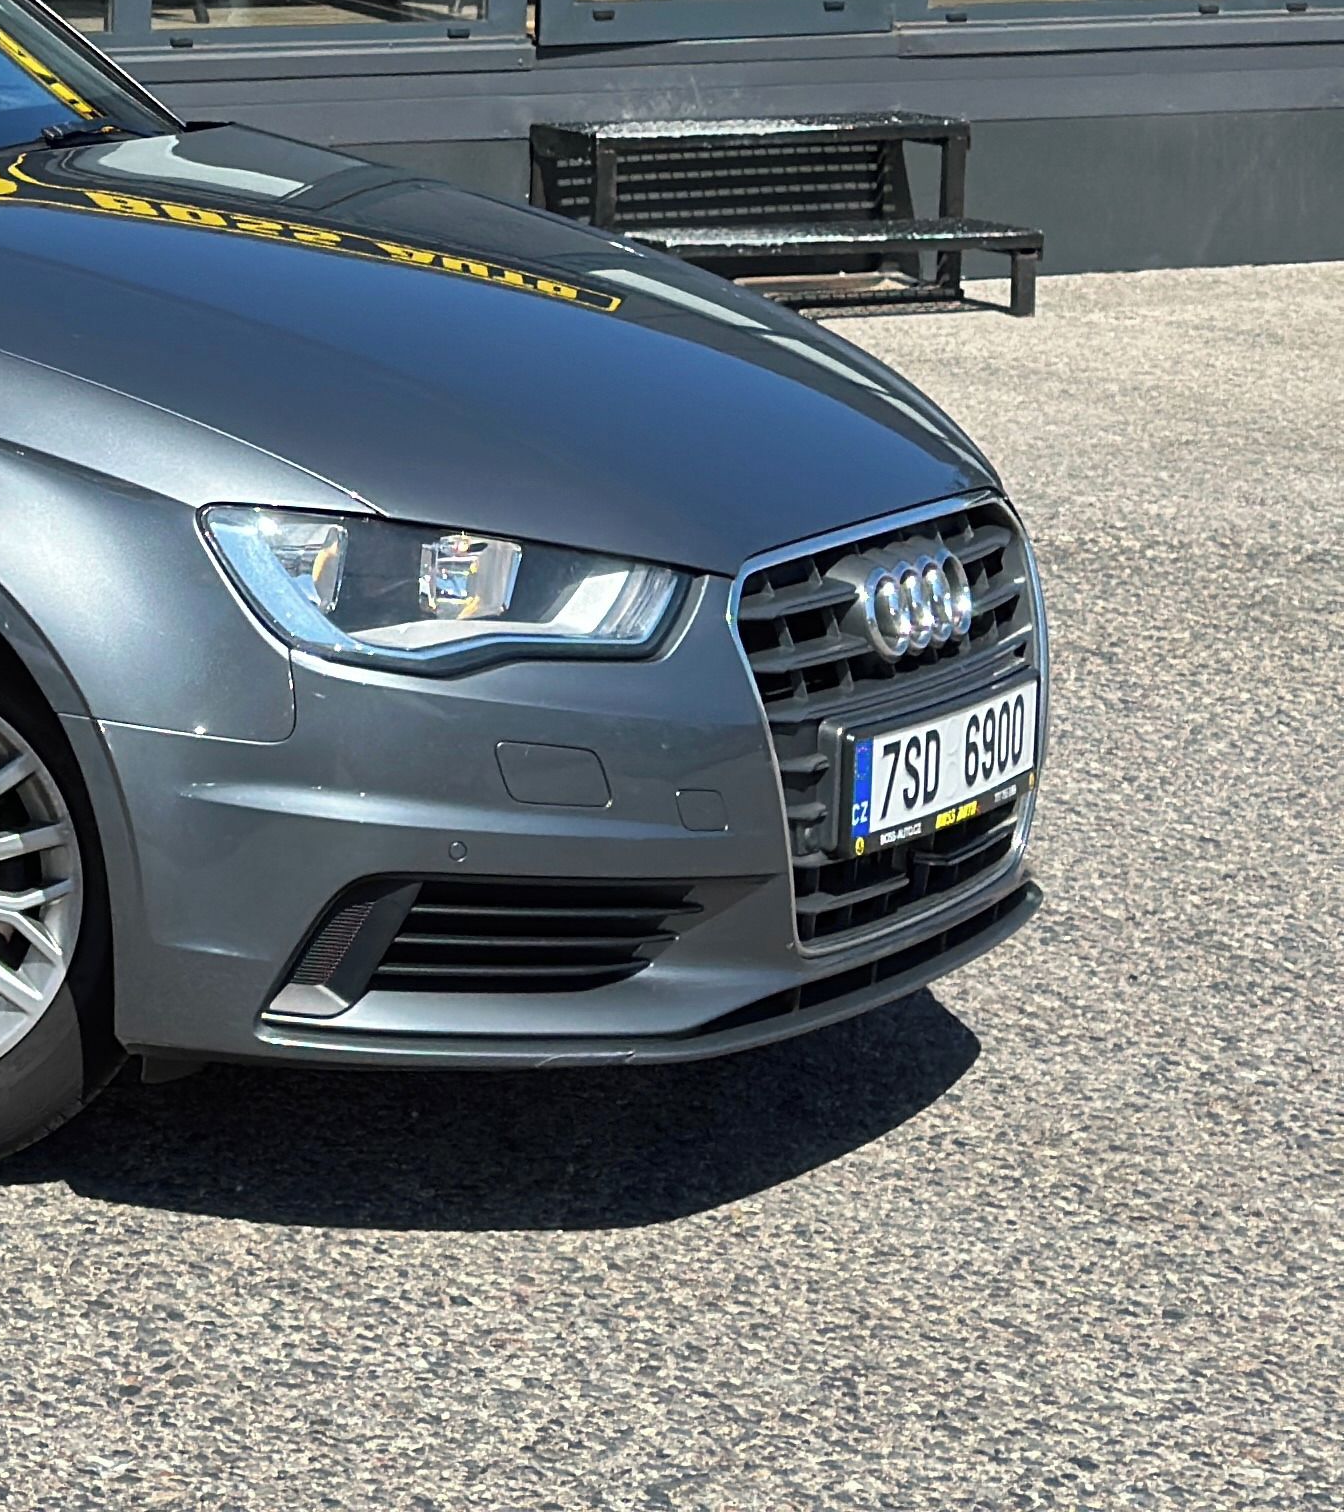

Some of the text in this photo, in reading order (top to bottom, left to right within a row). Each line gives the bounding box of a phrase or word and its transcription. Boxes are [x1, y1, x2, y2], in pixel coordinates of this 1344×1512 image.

[879, 693, 1025, 821] 7SD 6900
[851, 800, 869, 826] CZ
